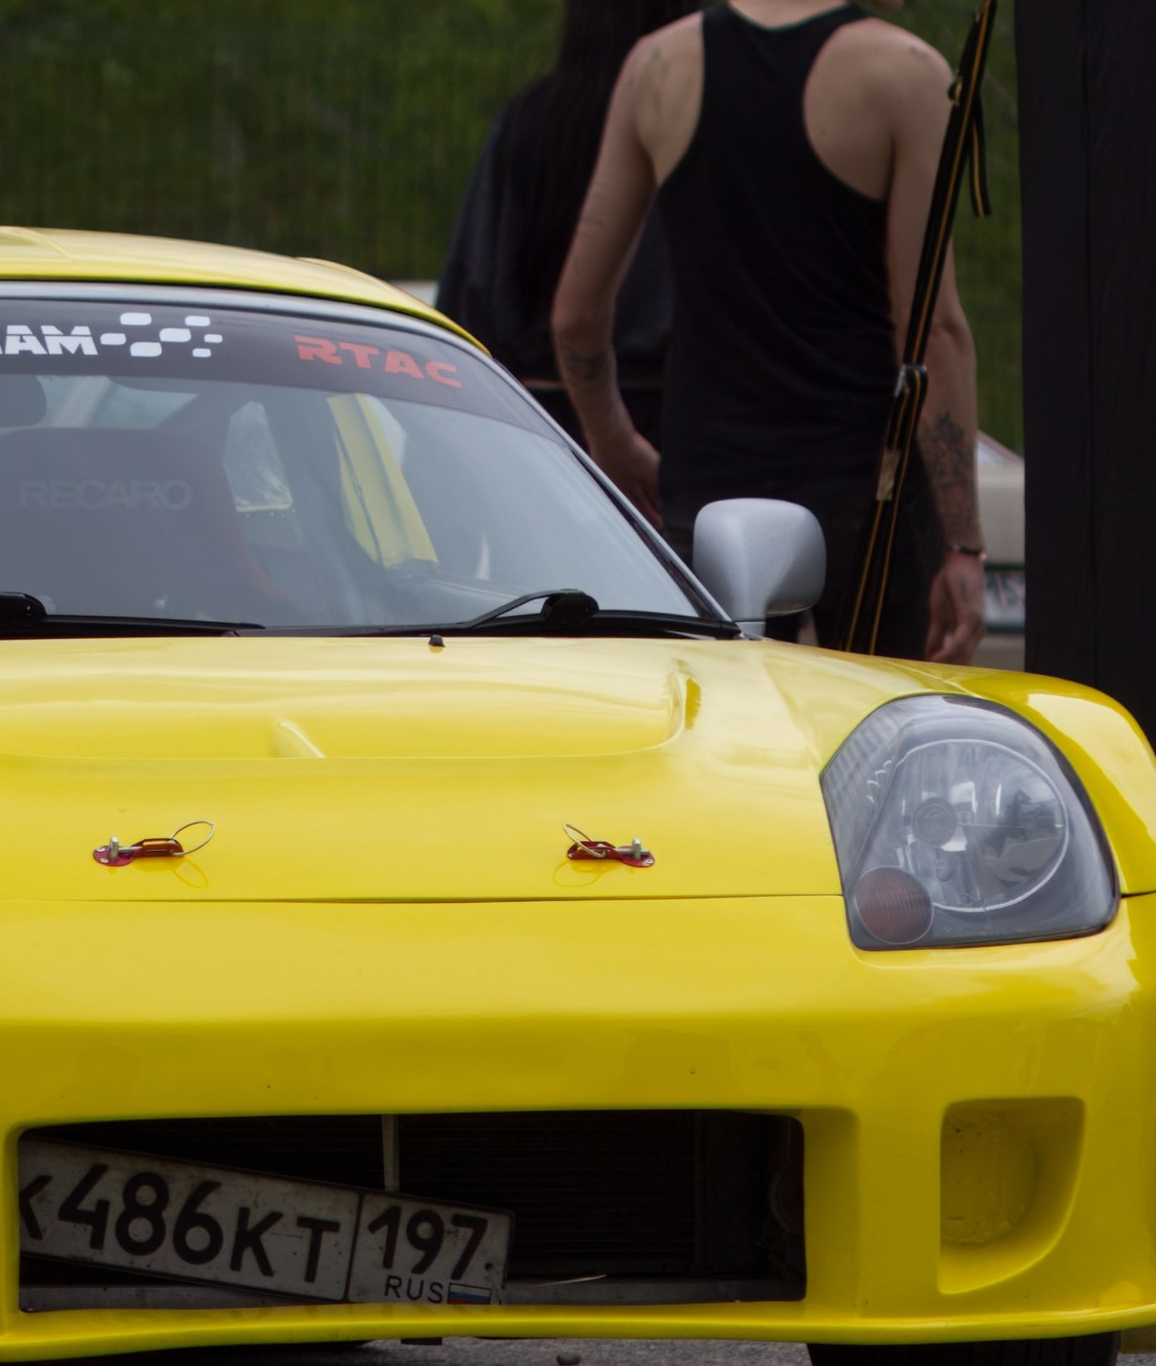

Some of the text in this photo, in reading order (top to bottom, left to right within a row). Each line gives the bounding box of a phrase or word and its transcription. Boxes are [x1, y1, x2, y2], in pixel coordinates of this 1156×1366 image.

[294, 334, 463, 389] RTAC
[19, 478, 194, 511] RECARO
[367, 1205, 489, 1281] 197
[384, 1274, 445, 1304] RUS
